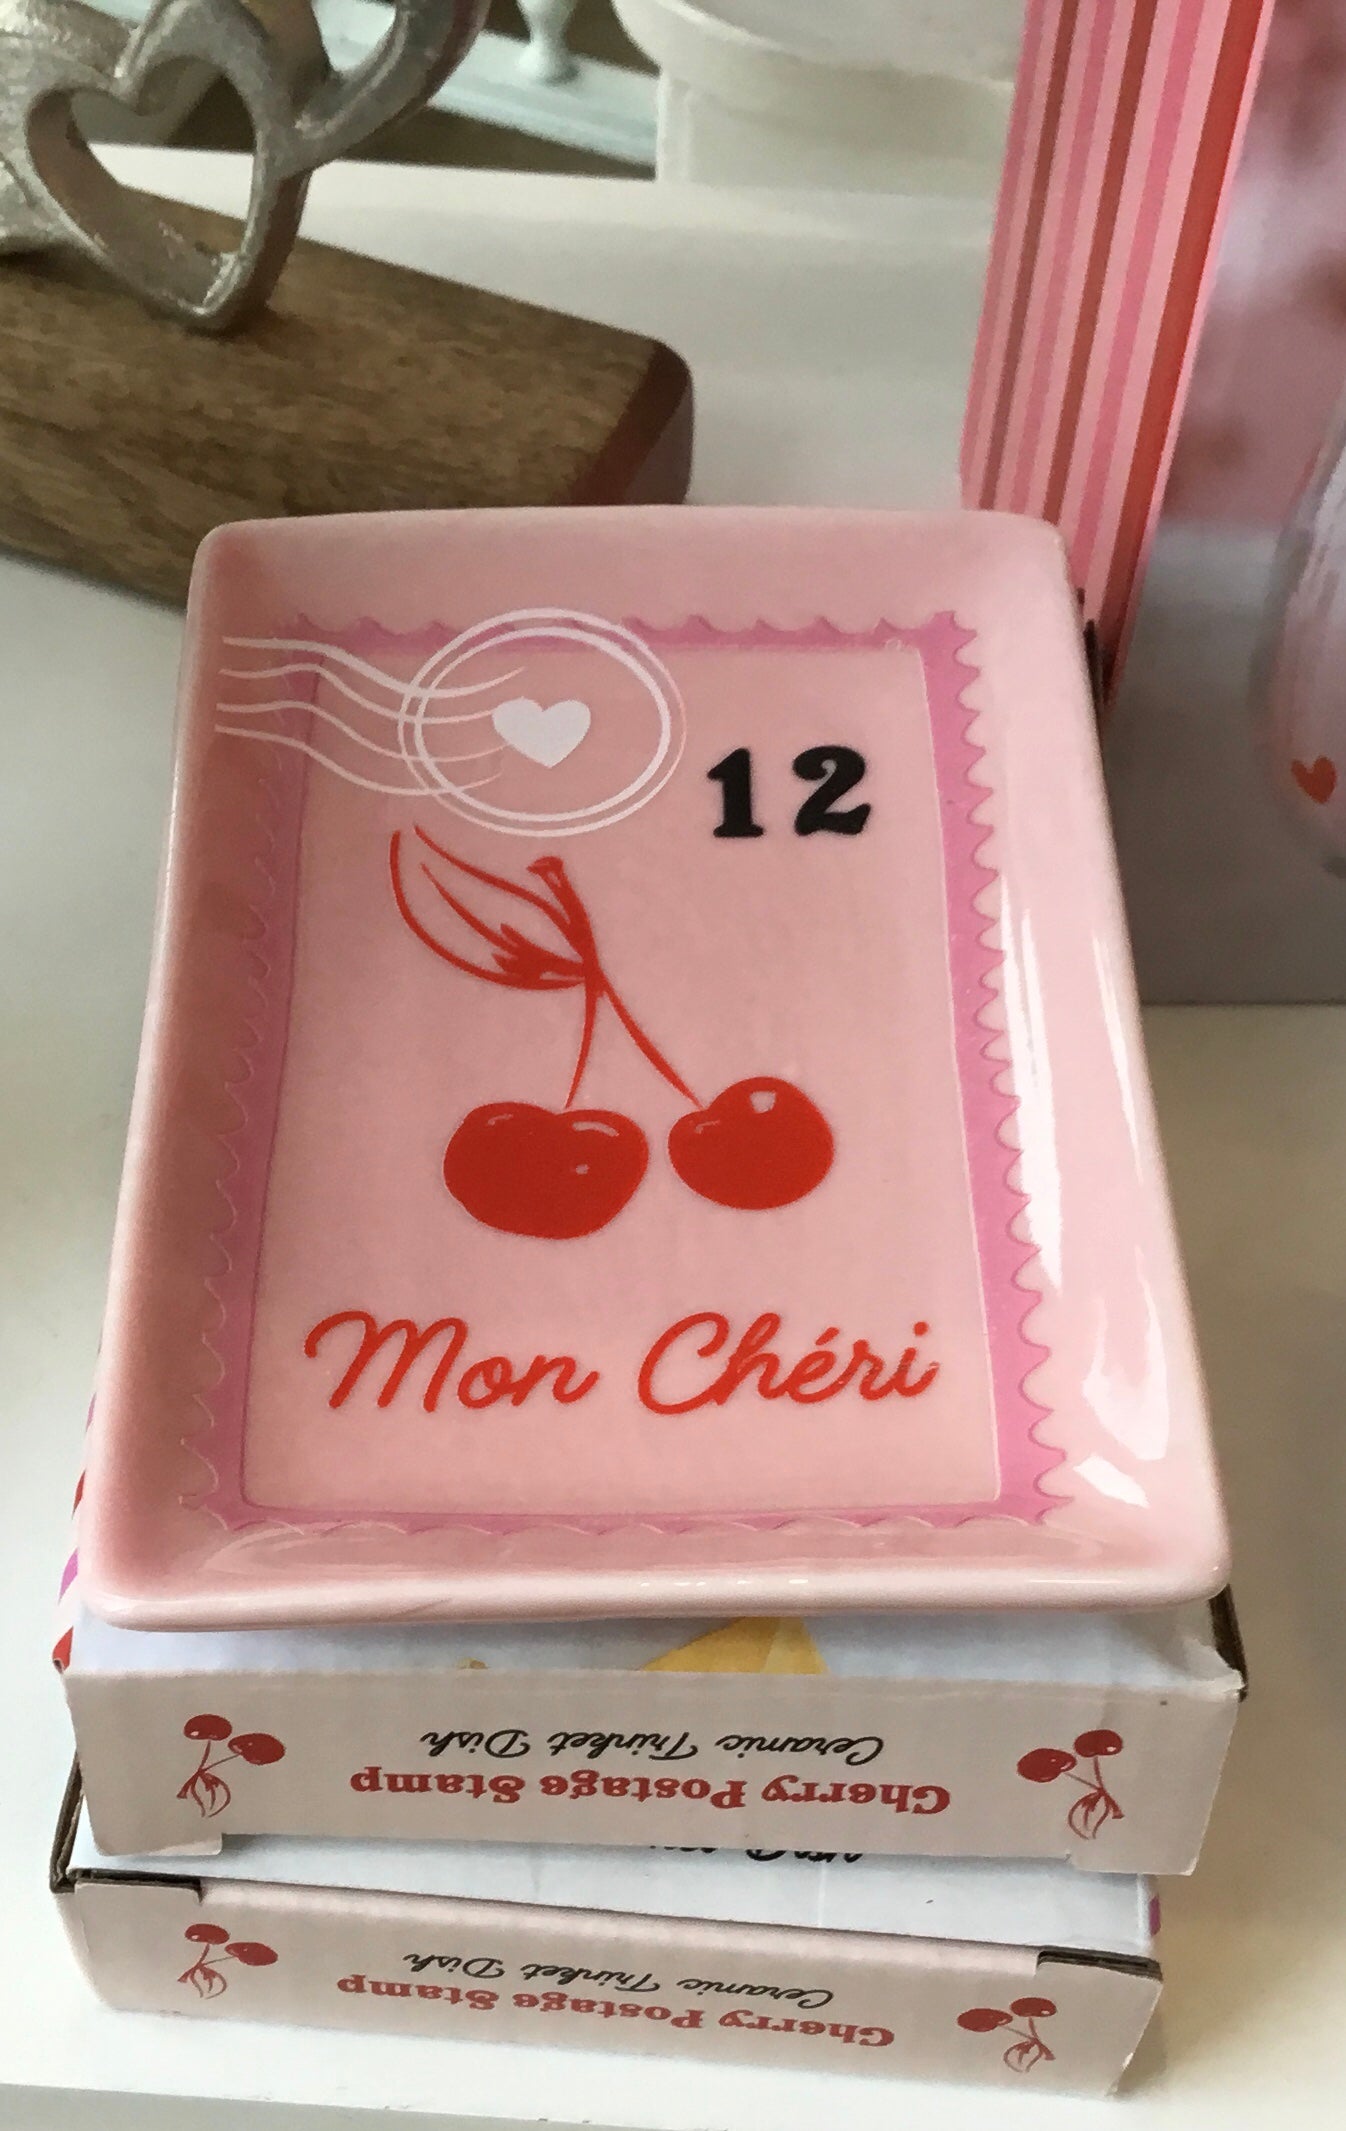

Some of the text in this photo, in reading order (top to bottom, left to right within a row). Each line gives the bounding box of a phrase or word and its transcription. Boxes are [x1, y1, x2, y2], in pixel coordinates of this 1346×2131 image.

[707, 745, 872, 838] 12
[304, 1310, 940, 1415] Mon Chéri
[420, 1729, 884, 1766] Ceramic Trinket Dish
[350, 1766, 951, 1815] Cherry Postage Stamp
[337, 1974, 895, 2047] Cherry Postage Stamp
[403, 1953, 834, 2009] Ceramic Trinket Dish
